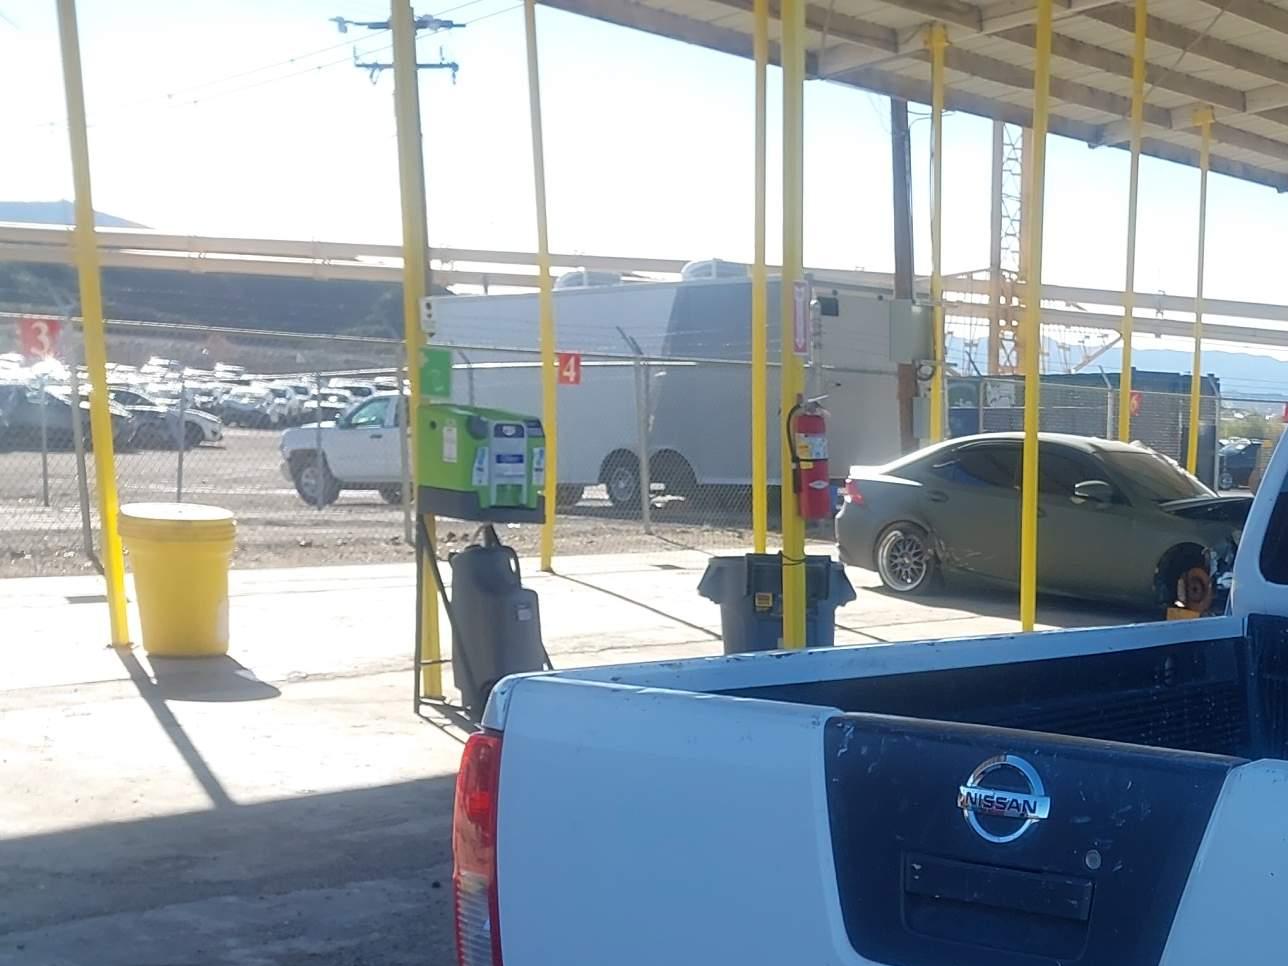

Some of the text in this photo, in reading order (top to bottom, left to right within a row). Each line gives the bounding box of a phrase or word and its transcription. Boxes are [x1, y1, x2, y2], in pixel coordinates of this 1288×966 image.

[31, 321, 51, 356] 3
[562, 355, 577, 382] 4
[965, 791, 1038, 815] NISSAN
